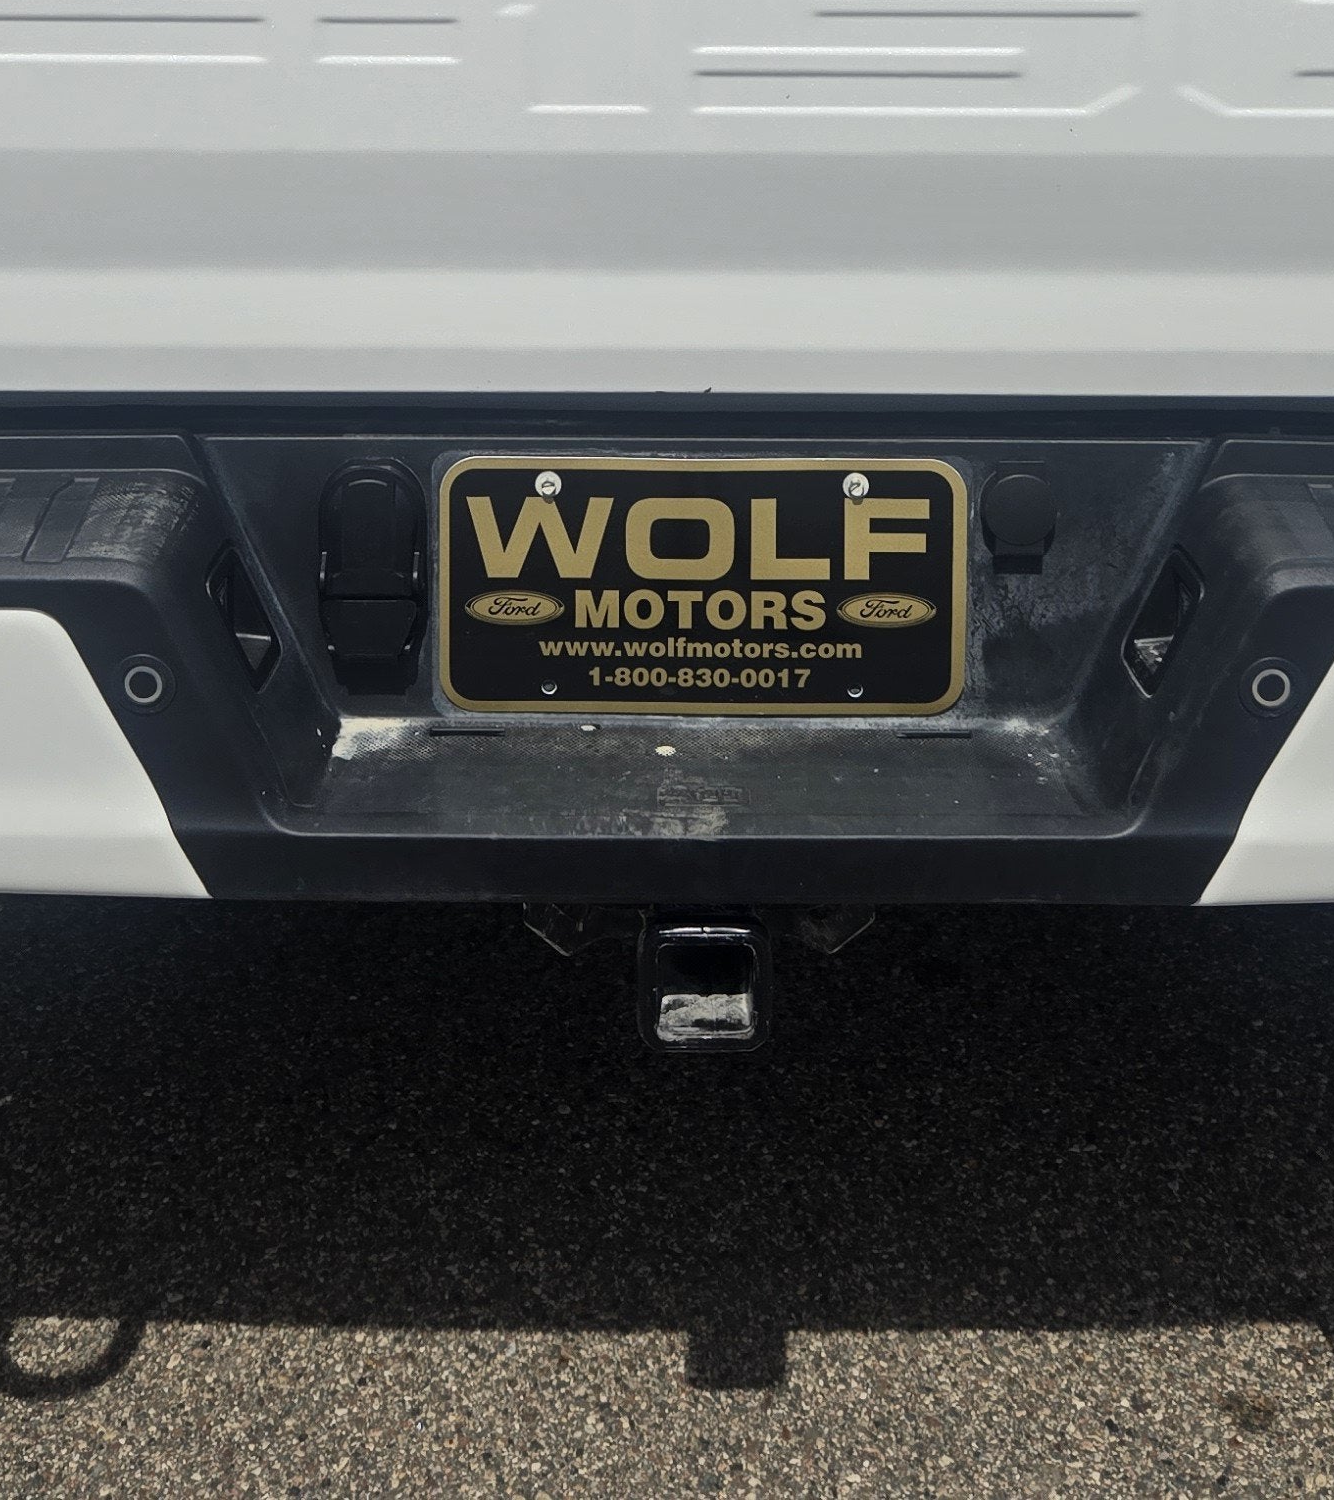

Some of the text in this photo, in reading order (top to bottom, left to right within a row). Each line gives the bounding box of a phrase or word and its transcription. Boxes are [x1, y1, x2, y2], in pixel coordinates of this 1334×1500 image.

[466, 495, 931, 581] WOLF
[487, 595, 543, 618] Ford
[574, 588, 827, 631] MOTORS
[859, 597, 914, 620] Ford
[539, 636, 863, 659] www.wolfmotors.com
[588, 666, 812, 689] 1-800-830-0017
